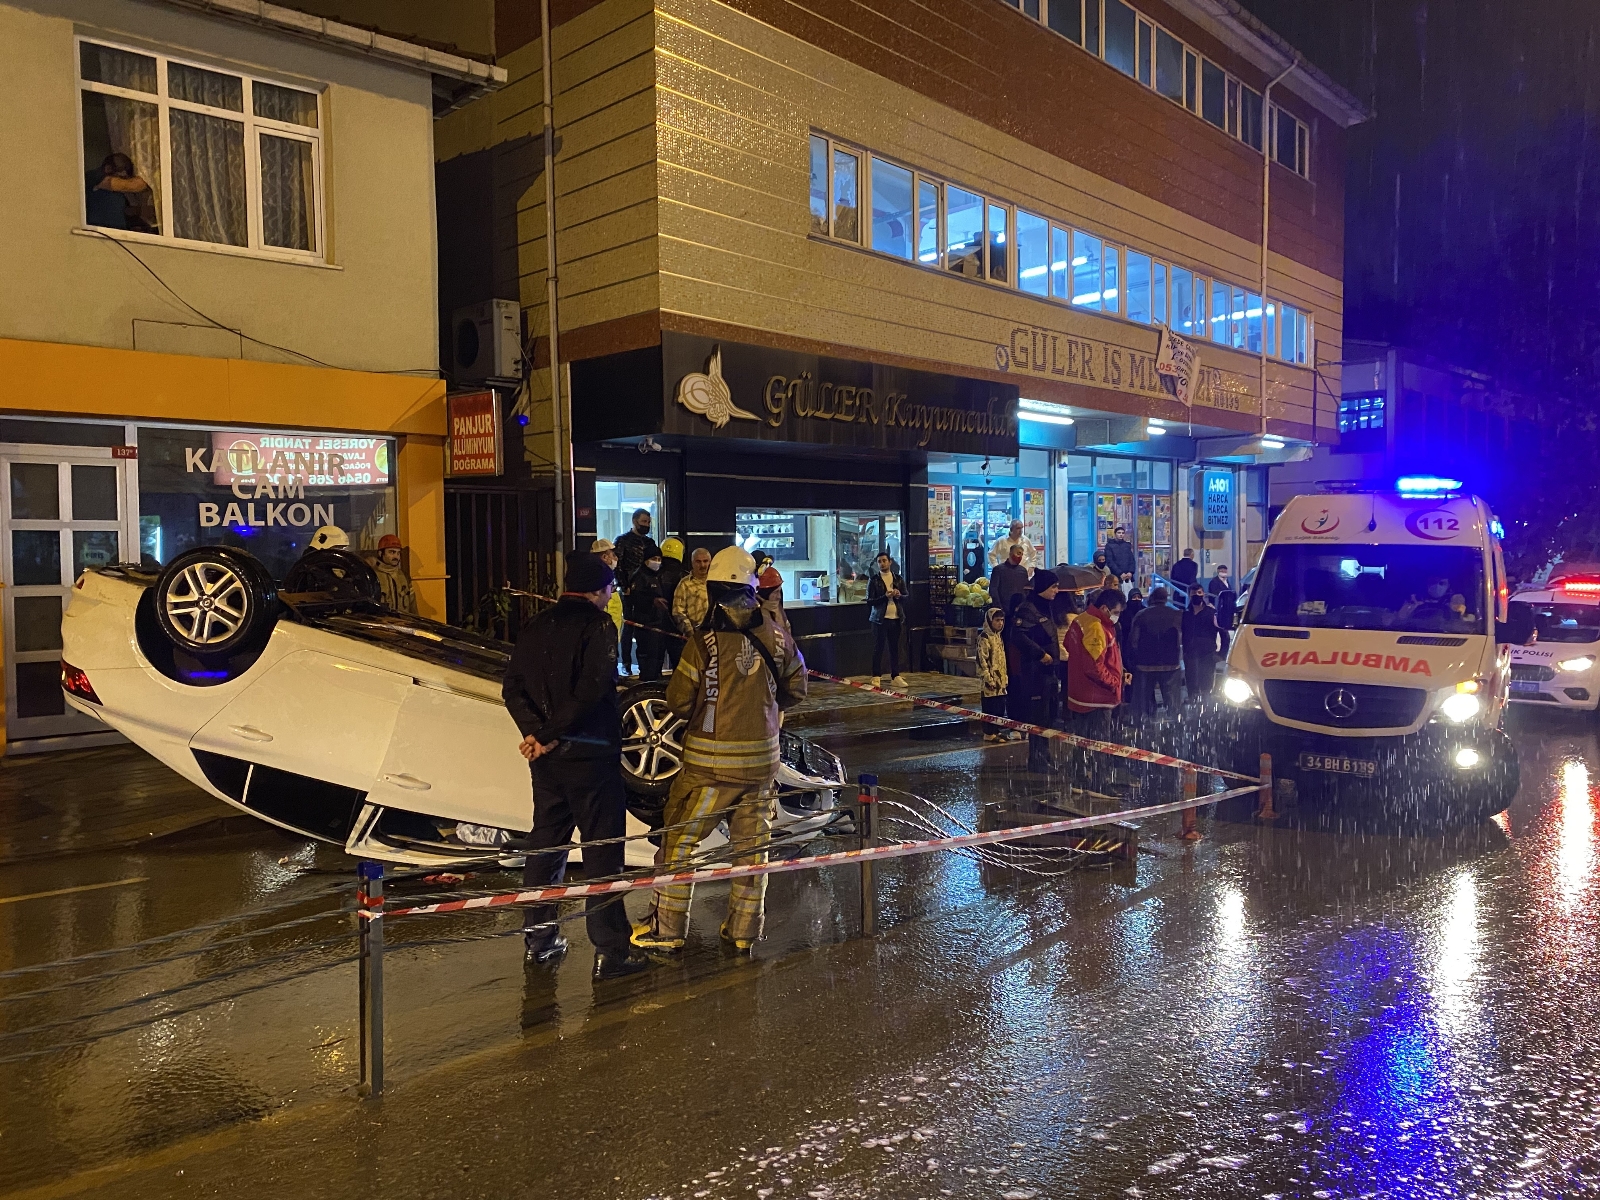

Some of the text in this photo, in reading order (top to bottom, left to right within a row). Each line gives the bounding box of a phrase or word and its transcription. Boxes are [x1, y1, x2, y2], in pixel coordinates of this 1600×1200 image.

[1010, 325, 1096, 381] GÜLER
[762, 370, 879, 427] GÜLER
[454, 413, 493, 435] PANJUR
[185, 447, 346, 476] KATLANIR
[453, 456, 495, 471] DOĞRAMA
[231, 475, 305, 500] CAM
[1207, 493, 1229, 504] HARCA
[199, 502, 335, 527] BALKON
[1207, 504, 1229, 514] HARCA
[1418, 518, 1460, 531] 112
[1307, 756, 1322, 769] 34
[1324, 757, 1340, 771] BH
